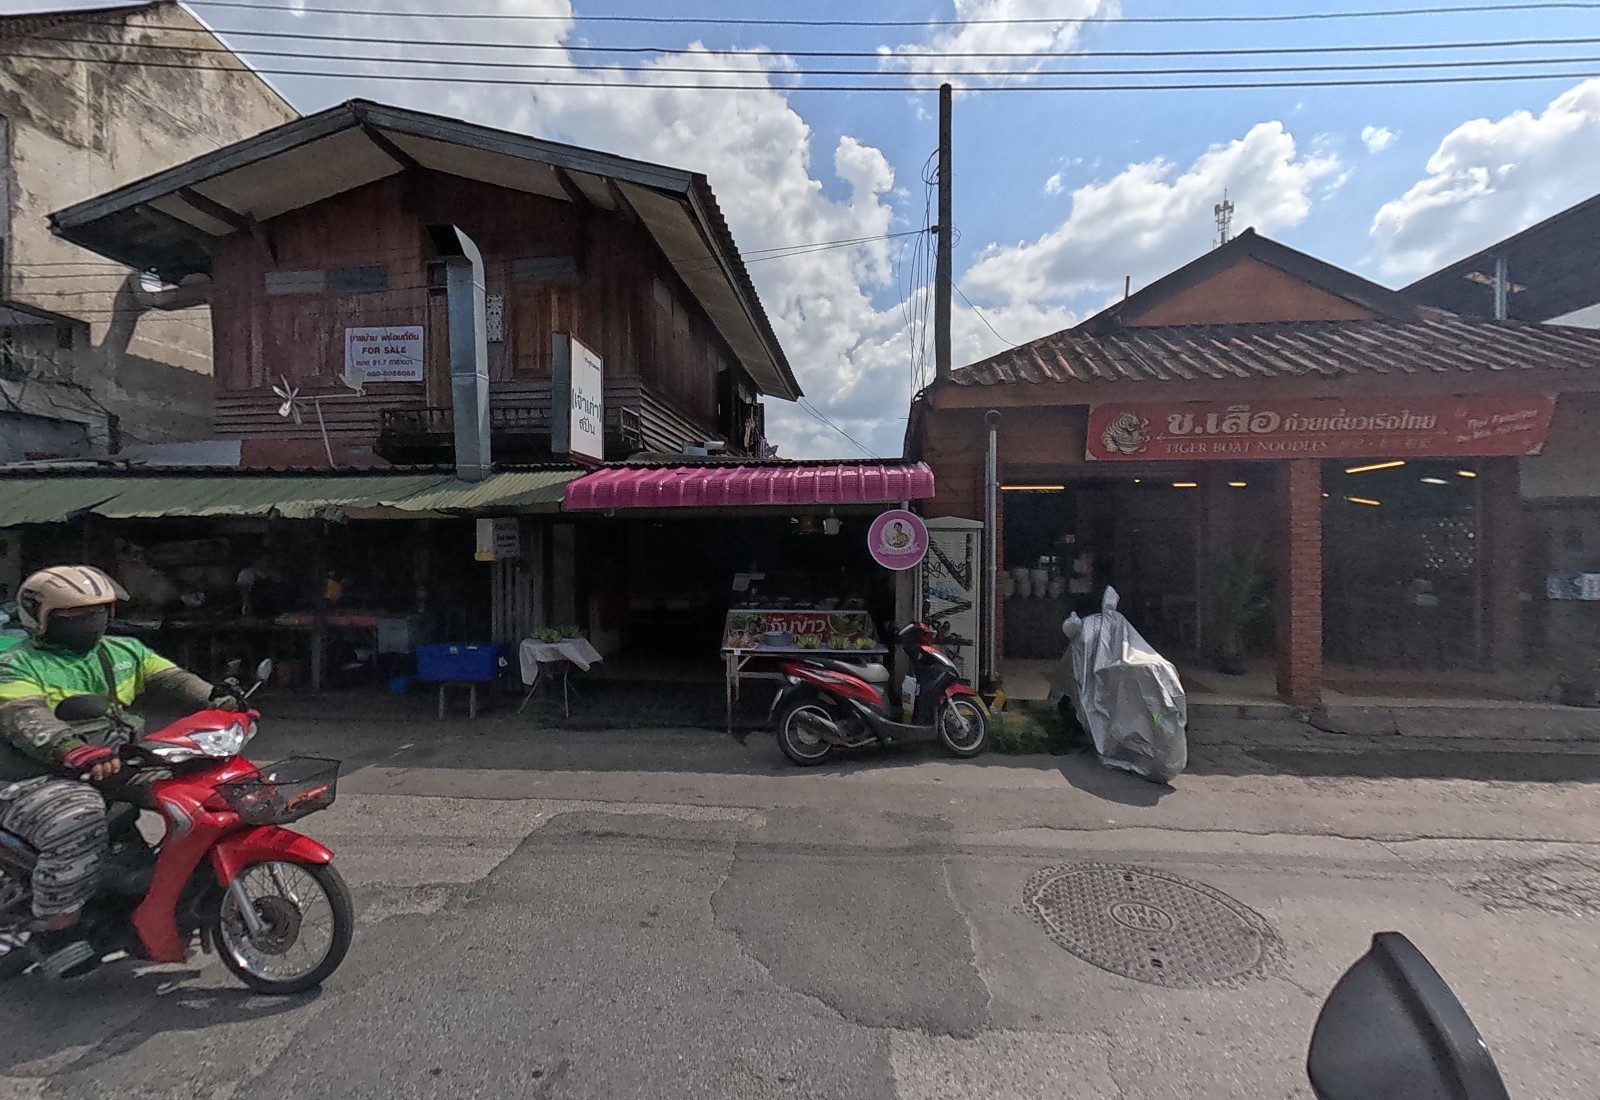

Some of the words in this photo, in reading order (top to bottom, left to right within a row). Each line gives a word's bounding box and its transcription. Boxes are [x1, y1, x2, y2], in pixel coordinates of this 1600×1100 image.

[362, 346, 380, 355] FOR
[384, 346, 407, 354] SALE
[1166, 442, 1208, 454] TIGER
[1213, 442, 1250, 453] BOAT
[1258, 440, 1328, 452] NOODLES
